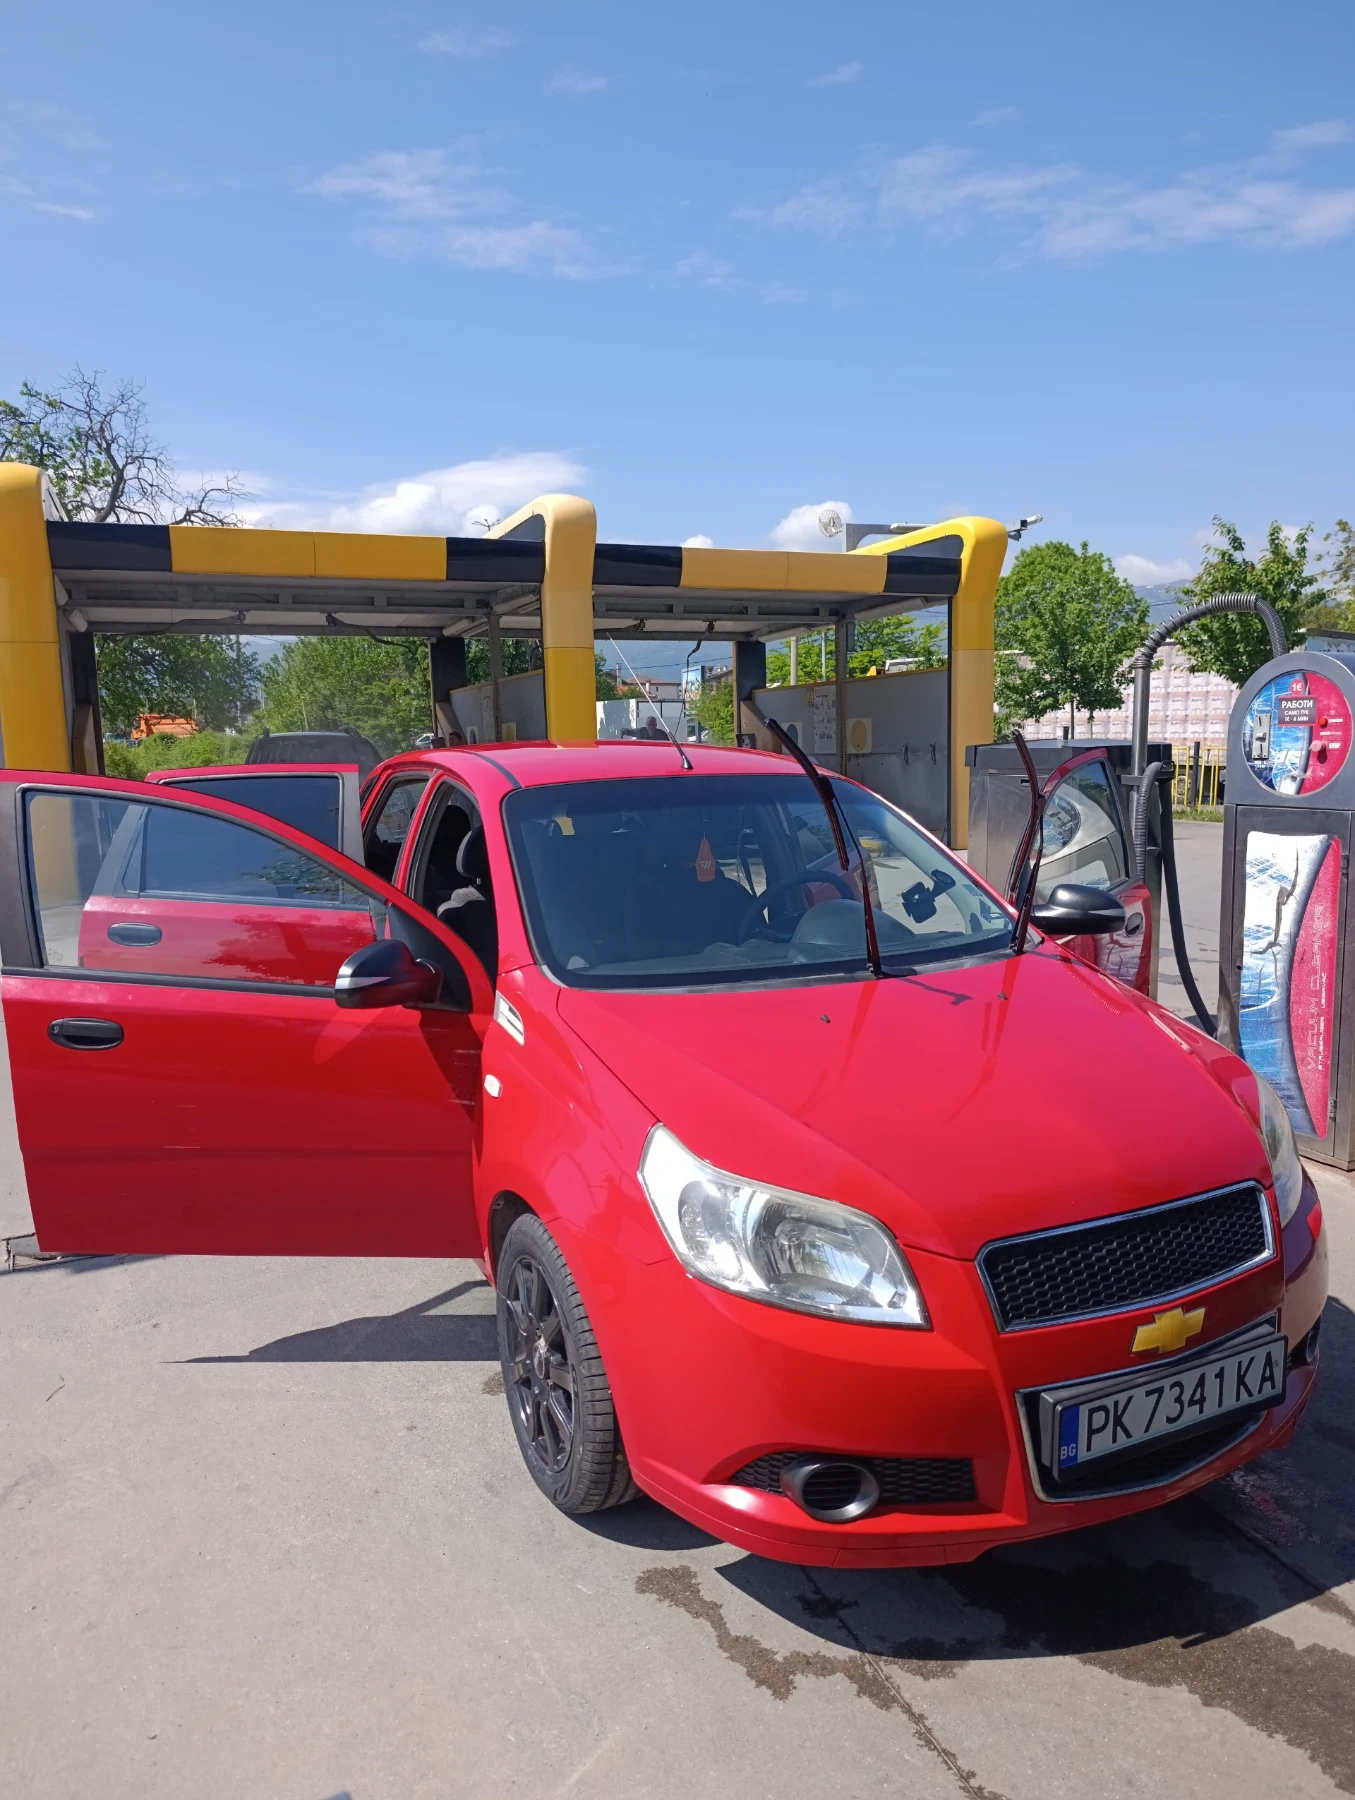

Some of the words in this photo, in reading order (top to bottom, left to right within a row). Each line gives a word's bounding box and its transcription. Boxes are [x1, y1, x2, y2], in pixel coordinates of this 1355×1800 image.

[1281, 700, 1313, 709] РАБОТИ
[1292, 682, 1303, 692] 1€
[1310, 903, 1324, 991] CLEANER
[1307, 997, 1320, 1071] VACUUM
[1085, 1395, 1134, 1453] PK
[1060, 1443, 1077, 1460] BG
